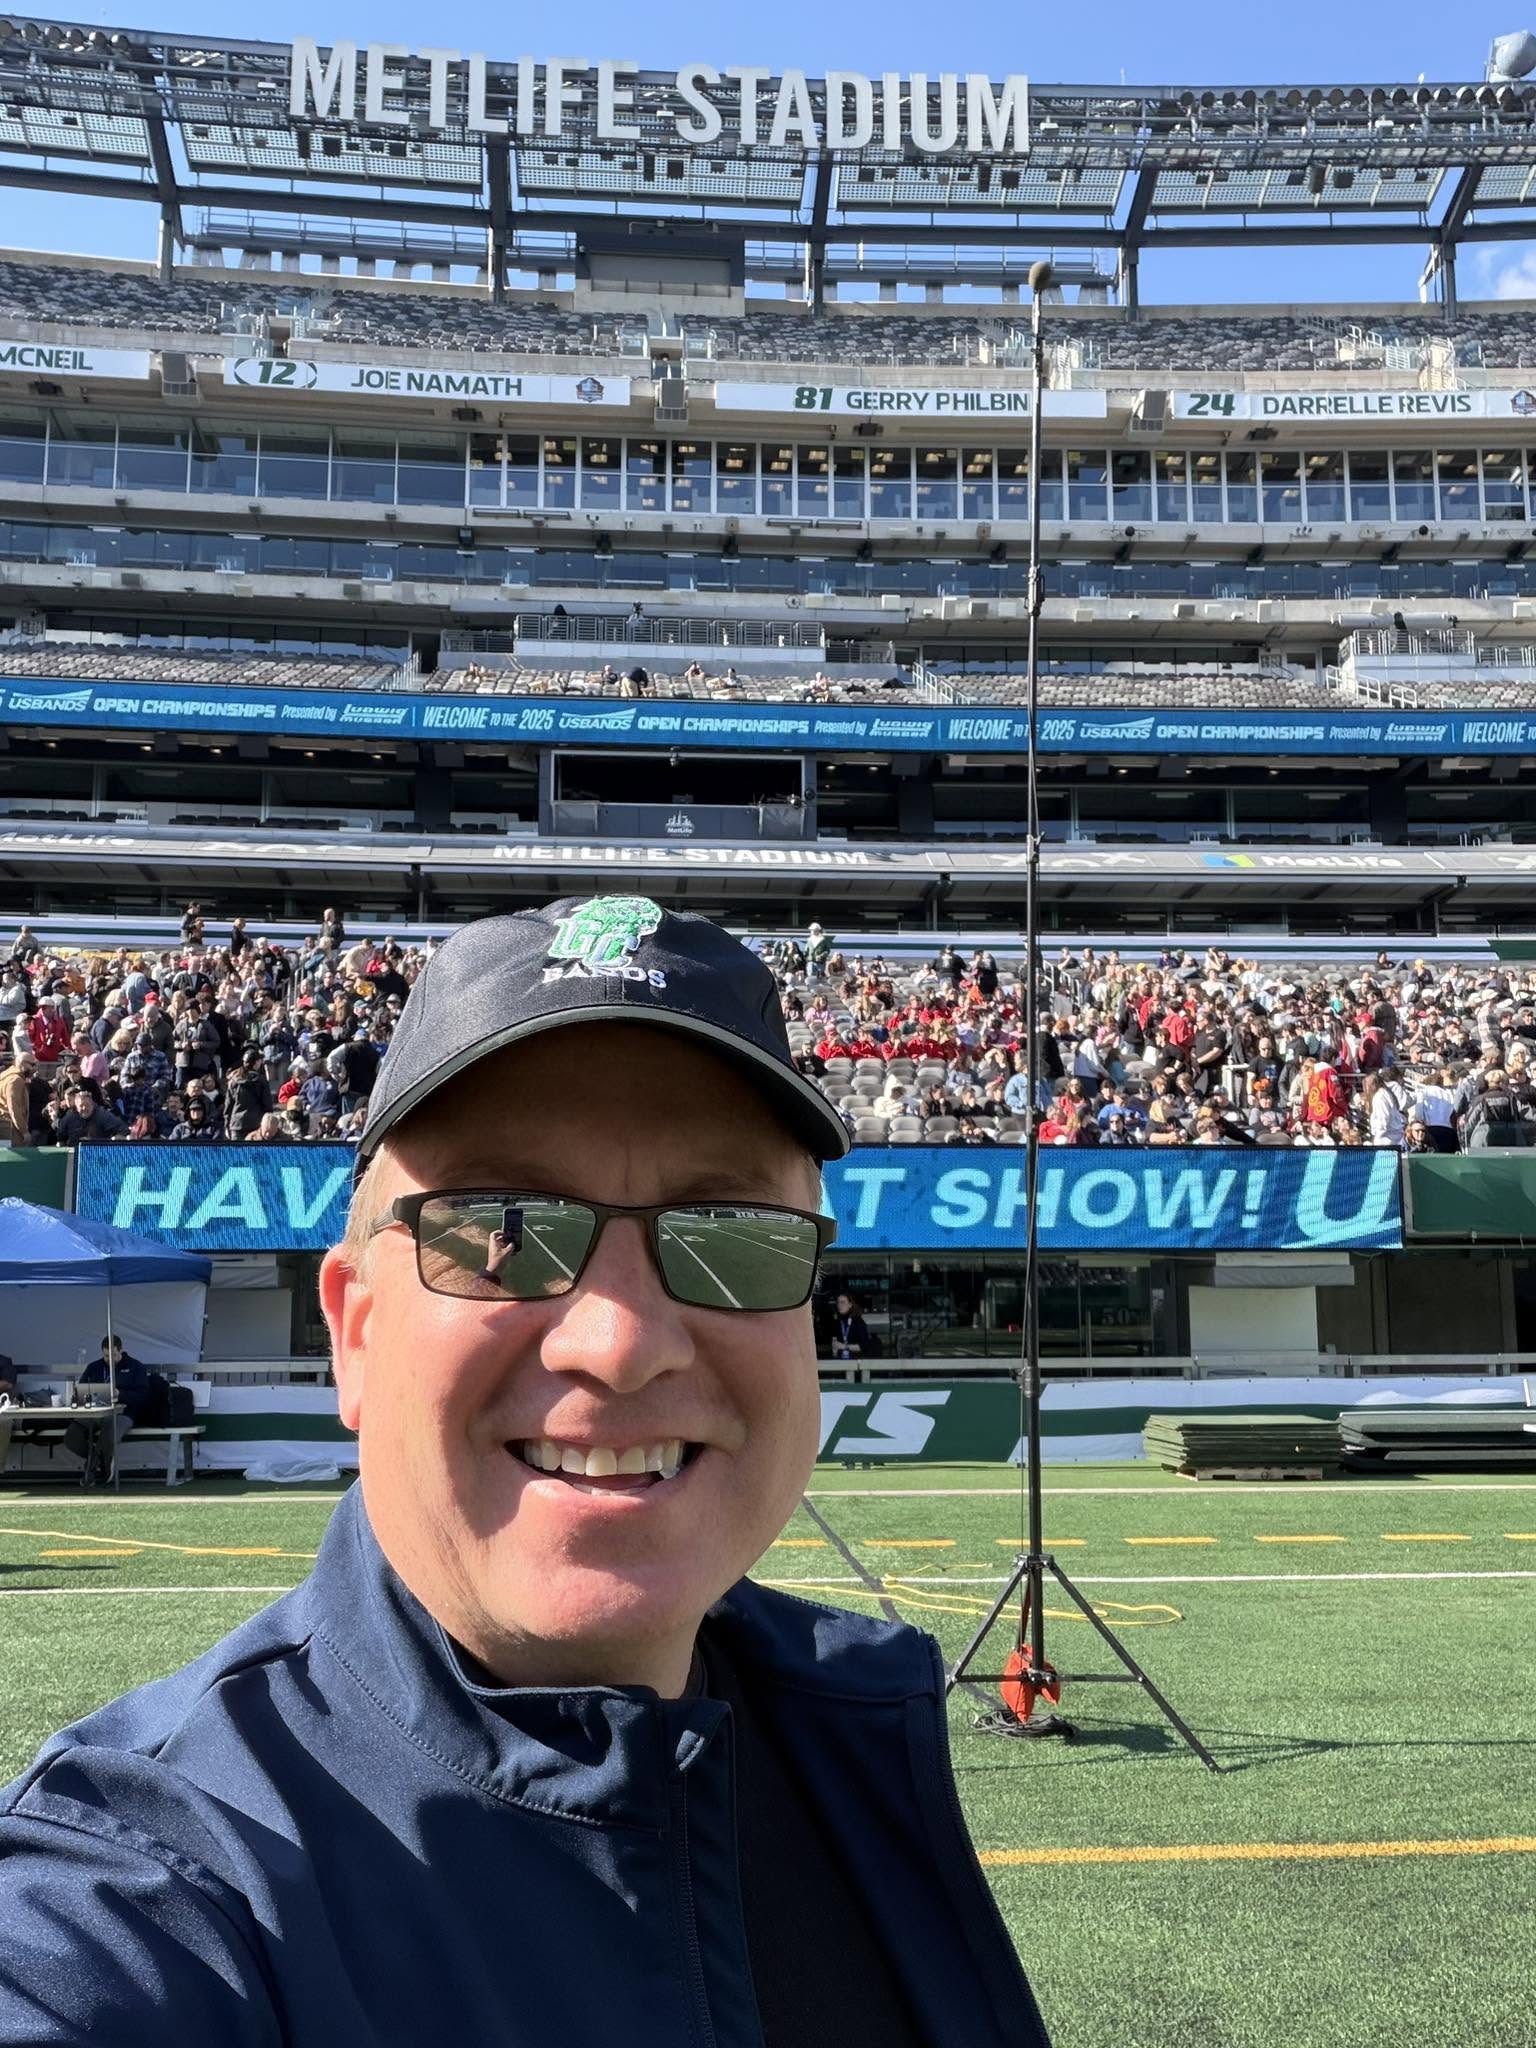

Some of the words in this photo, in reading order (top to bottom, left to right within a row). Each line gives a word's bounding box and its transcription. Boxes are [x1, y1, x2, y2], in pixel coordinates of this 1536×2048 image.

[290, 36, 641, 139] METLIFE
[675, 62, 1030, 152] STADIUM
[0, 347, 93, 370] MCNEIL
[257, 361, 297, 385] 12
[351, 368, 401, 390] JOE
[406, 372, 522, 396] NAMATH
[794, 386, 833, 410] 81
[846, 391, 929, 411] GERRY
[936, 392, 1029, 412] PHILBIN
[1187, 393, 1235, 416] 24
[1262, 395, 1393, 415] DARRELLE
[1399, 394, 1472, 414] REVIS
[9, 697, 87, 711] USBANDS
[93, 698, 139, 712] OPEN
[142, 700, 276, 718] CHAMPIONSHIPS
[281, 704, 323, 720] Presented
[324, 706, 337, 721] by
[422, 706, 490, 728] WELCOME
[490, 712, 501, 726] TO
[502, 713, 518, 727] THE
[519, 708, 556, 730] 2025
[559, 717, 633, 730] USBANDS
[637, 716, 681, 731] OPEN
[683, 717, 809, 734] CHAMPIONSHIPS
[814, 720, 853, 734] Presented
[854, 720, 867, 735] by
[949, 719, 1013, 740] WELCOME
[1013, 724, 1024, 737] TO
[1041, 719, 1076, 740] 2025
[1080, 727, 1152, 739] USBANDS
[1156, 725, 1198, 738] OPEN
[1201, 725, 1324, 740] CHAMPIONSHIPS
[1329, 725, 1369, 740] Presented
[1369, 726, 1382, 741] by
[1462, 721, 1527, 743] WELCOME
[493, 845, 671, 861] METLIFE
[685, 848, 869, 865] STADIUM
[542, 962, 667, 989] BANDS
[930, 1168, 1267, 1229] SHOW!
